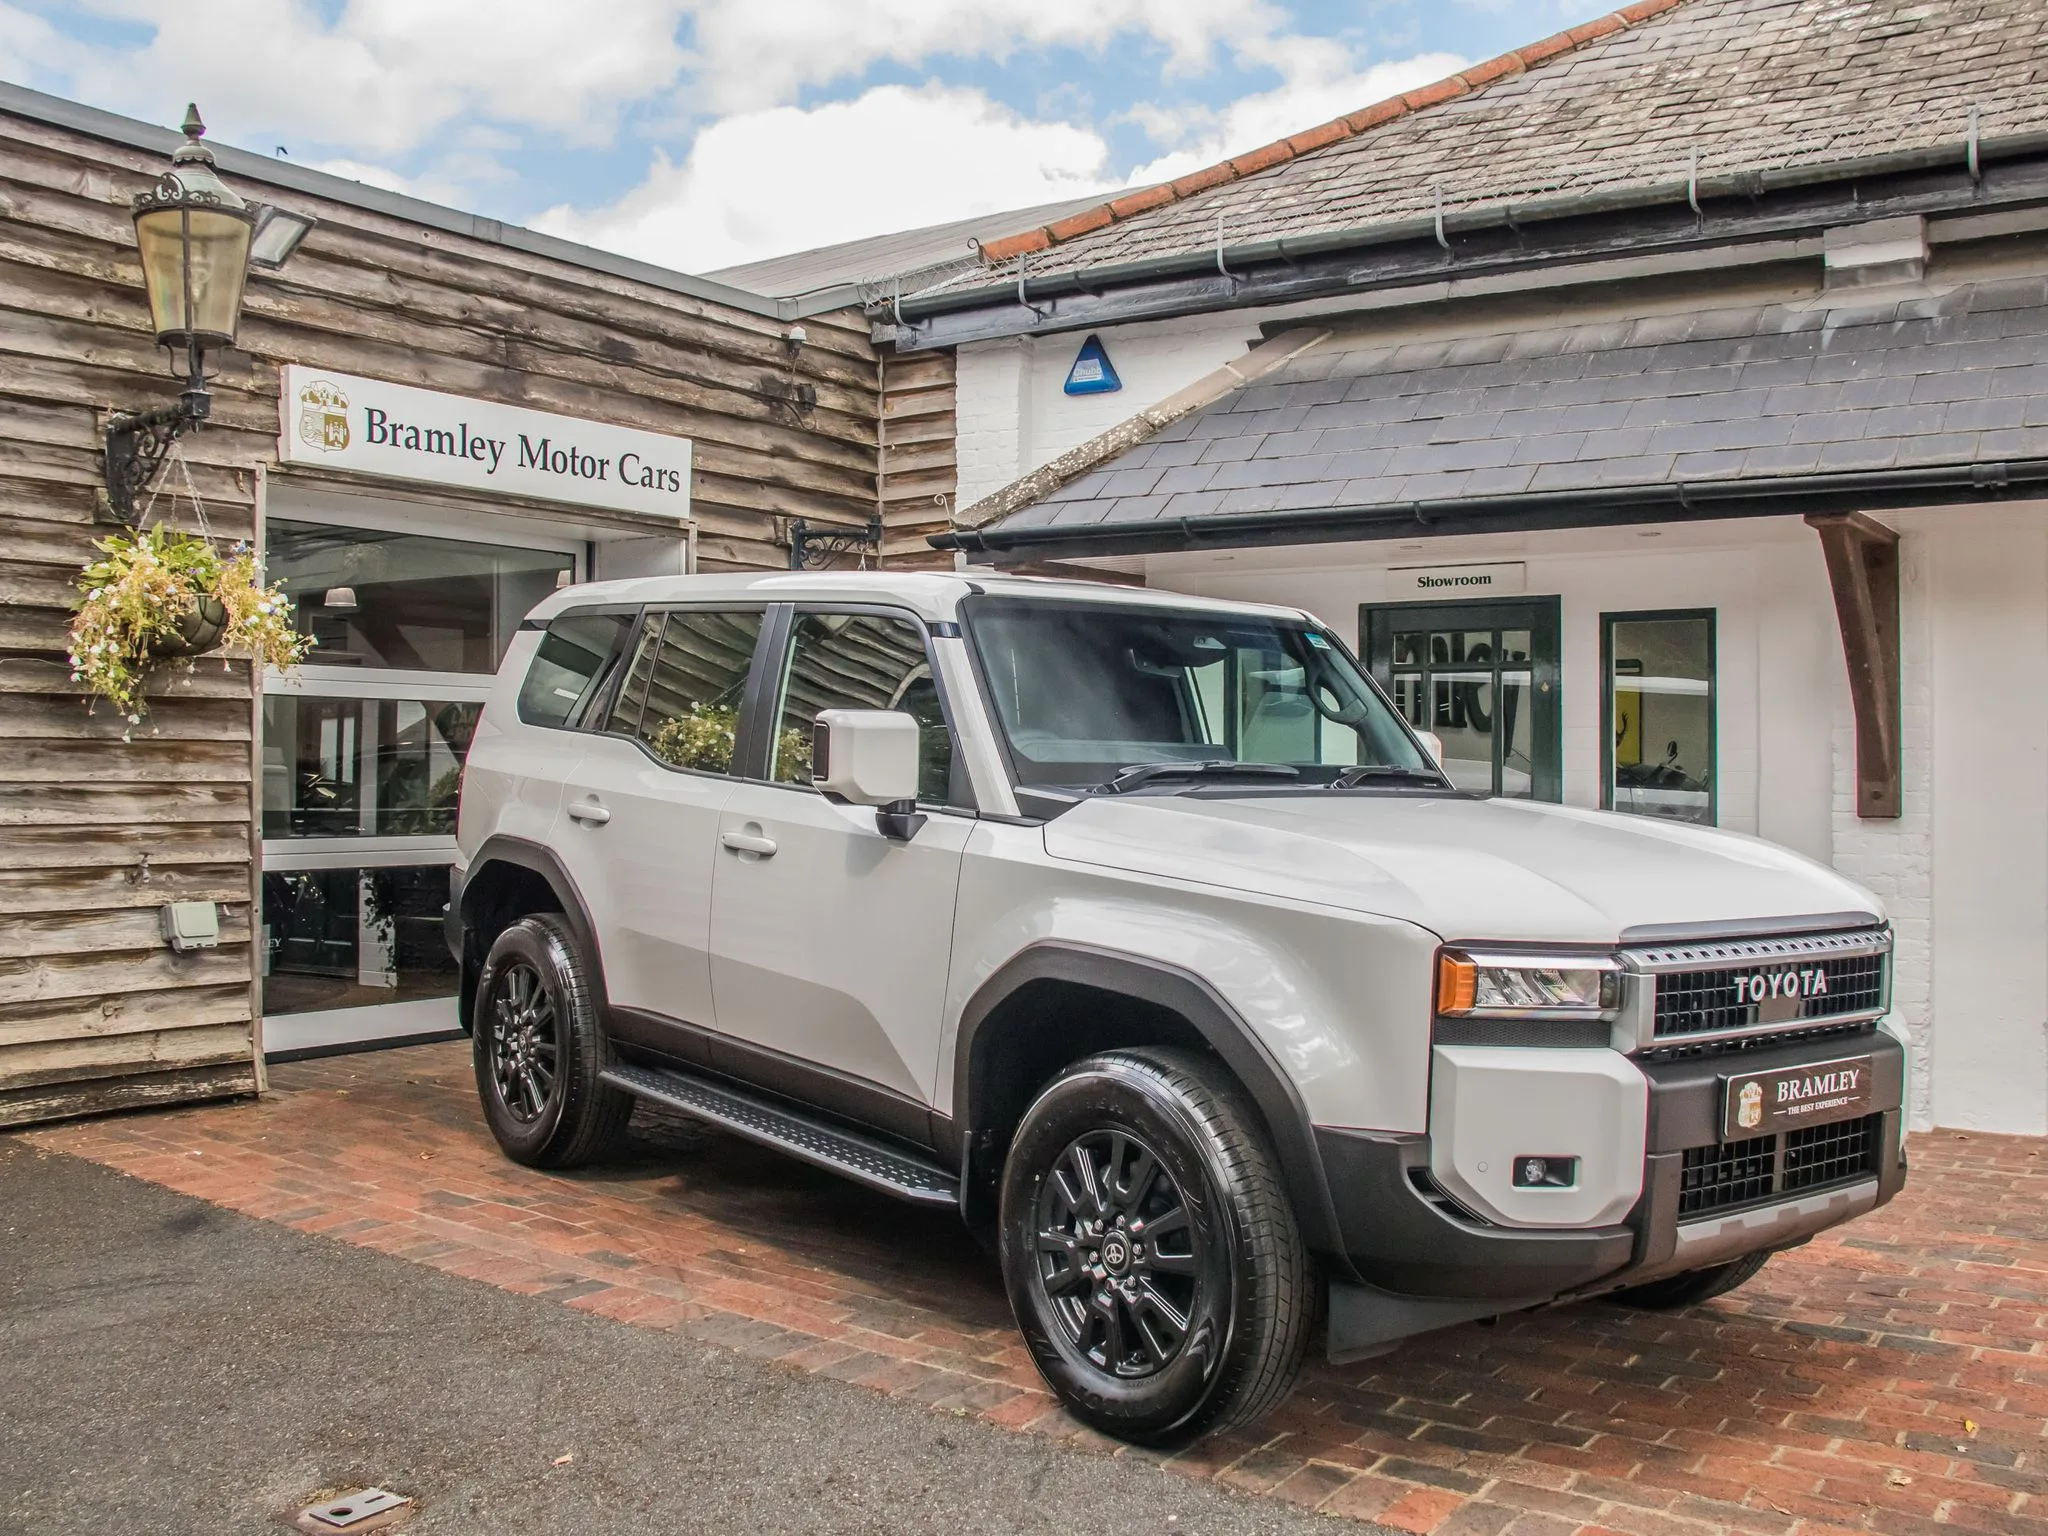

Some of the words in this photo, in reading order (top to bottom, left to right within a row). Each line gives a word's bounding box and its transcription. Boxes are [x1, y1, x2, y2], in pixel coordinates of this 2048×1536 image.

[364, 407, 506, 475] Bramley
[517, 434, 610, 481] Motor
[618, 453, 680, 493] Cars
[1417, 575, 1492, 588] Showroom
[1734, 969, 1828, 1003] TOYOTA
[1777, 1068, 1859, 1102] BRAMLEY
[1788, 1105, 1800, 1115] THE
[1800, 1103, 1814, 1113] BEST
[1815, 1097, 1848, 1110] EXPERIENCE
